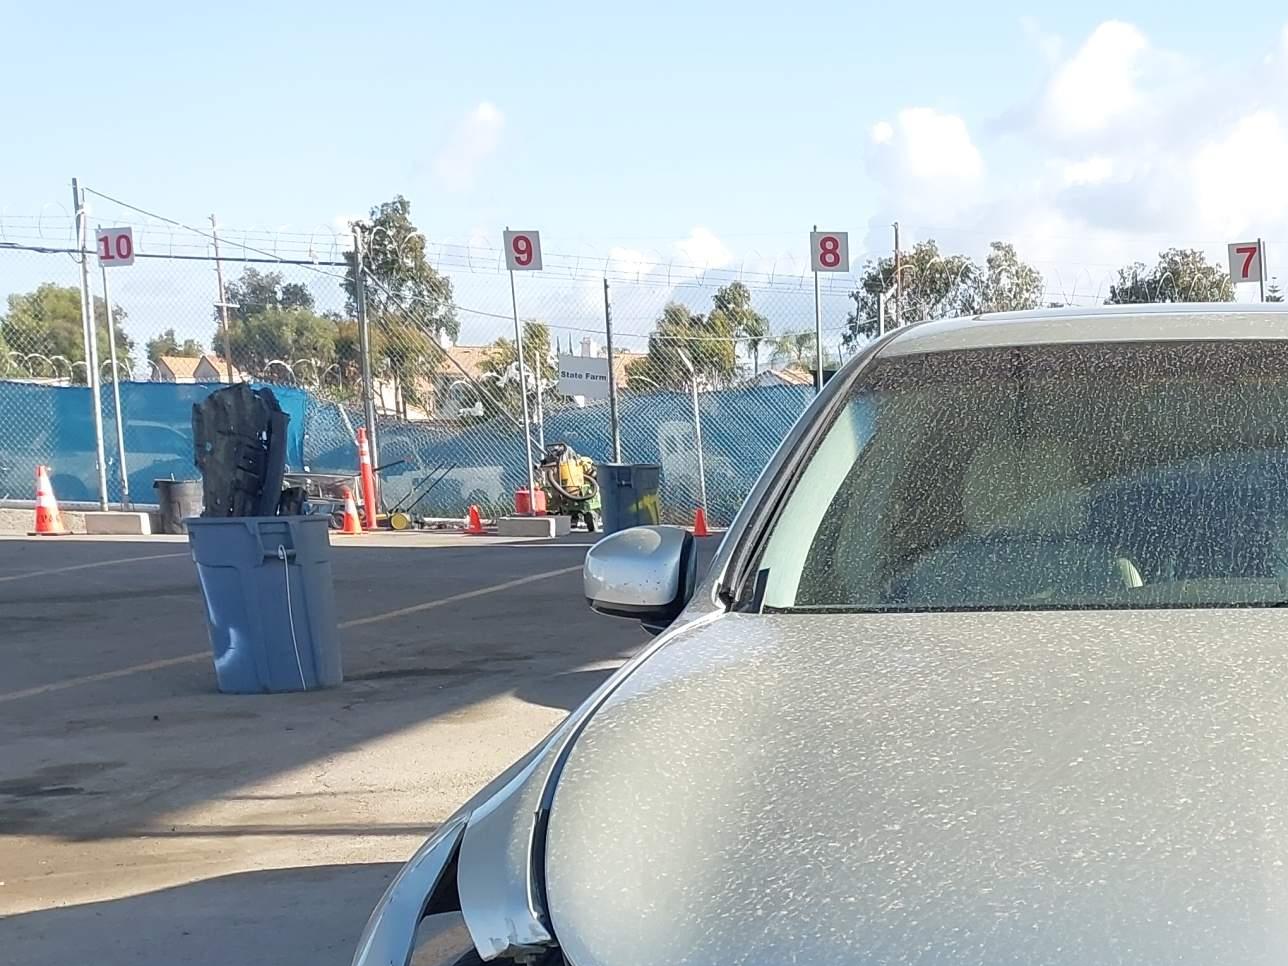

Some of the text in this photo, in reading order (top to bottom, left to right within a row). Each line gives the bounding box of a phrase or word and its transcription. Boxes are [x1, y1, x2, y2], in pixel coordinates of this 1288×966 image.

[98, 235, 132, 260] 10
[513, 235, 533, 266] 9
[820, 236, 841, 267] 8
[1236, 247, 1257, 278] 7
[561, 371, 607, 381] State Farm
